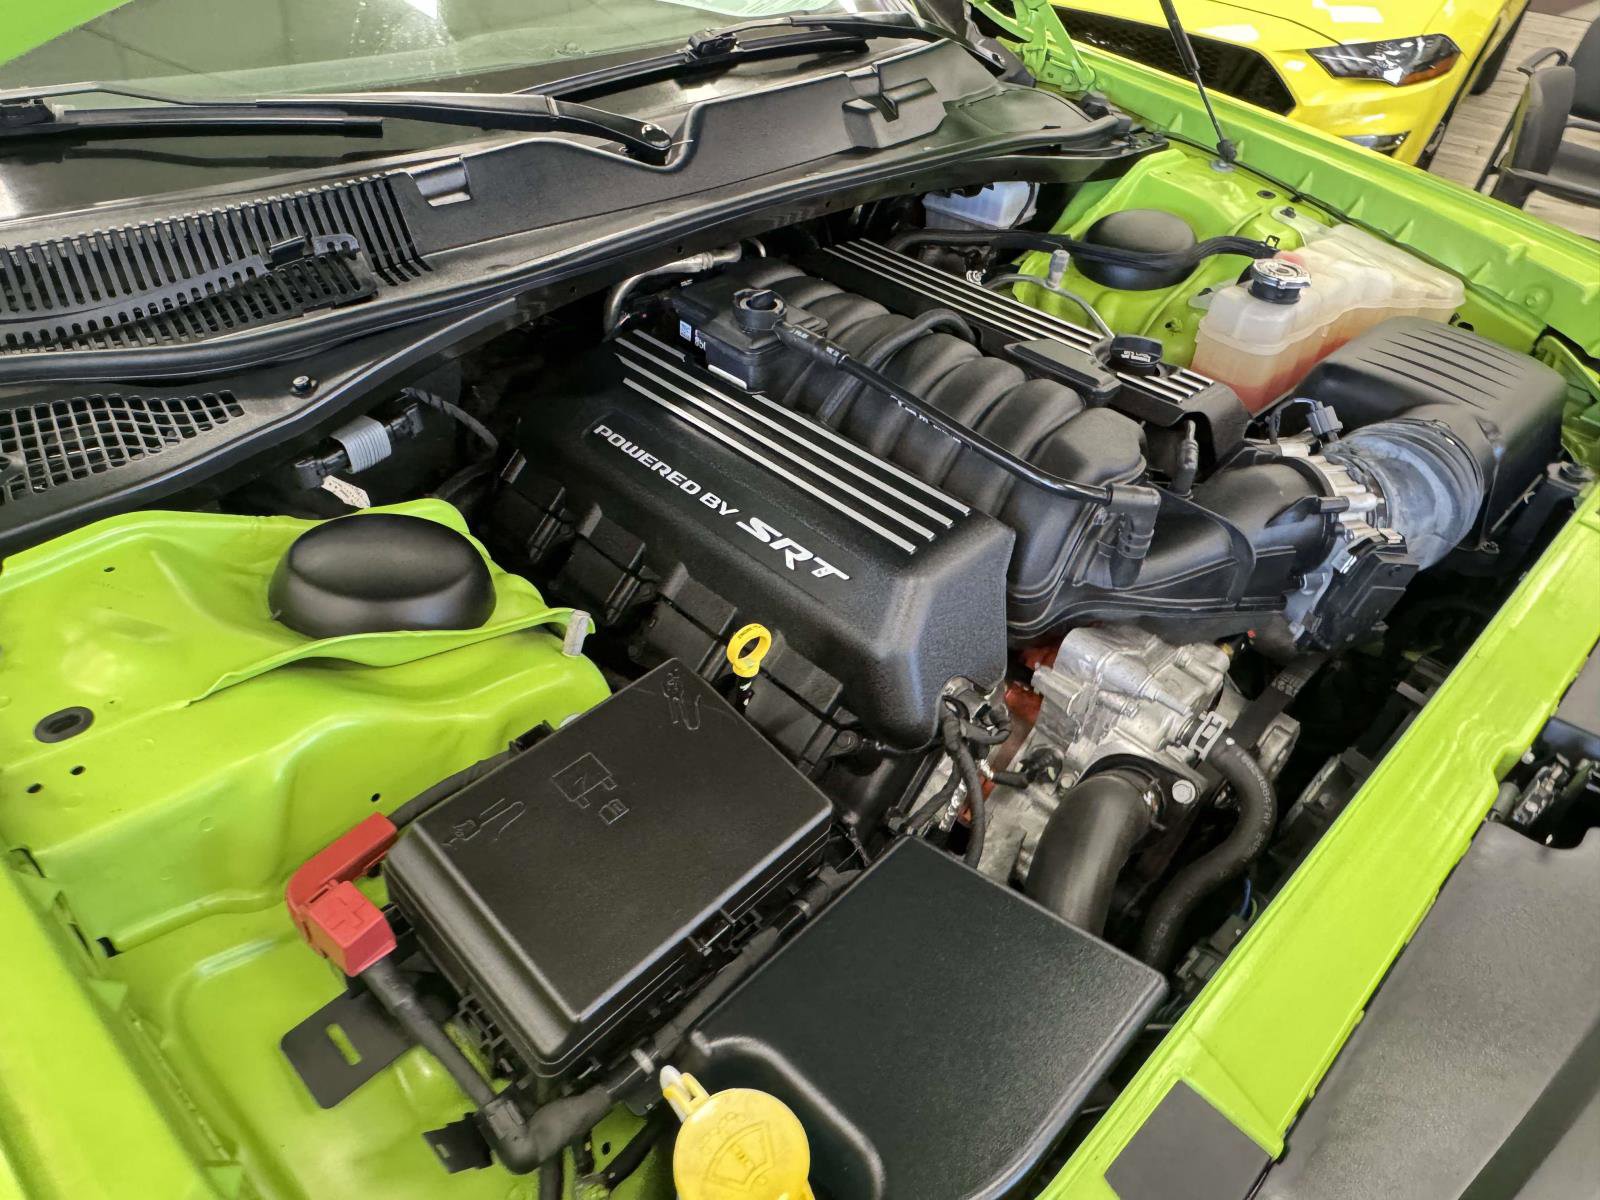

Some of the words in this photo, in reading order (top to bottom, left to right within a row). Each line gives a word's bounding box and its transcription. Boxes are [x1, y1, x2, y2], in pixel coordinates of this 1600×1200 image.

[593, 424, 701, 496] POWERED
[699, 492, 740, 517] BY
[736, 517, 850, 581] SRT
